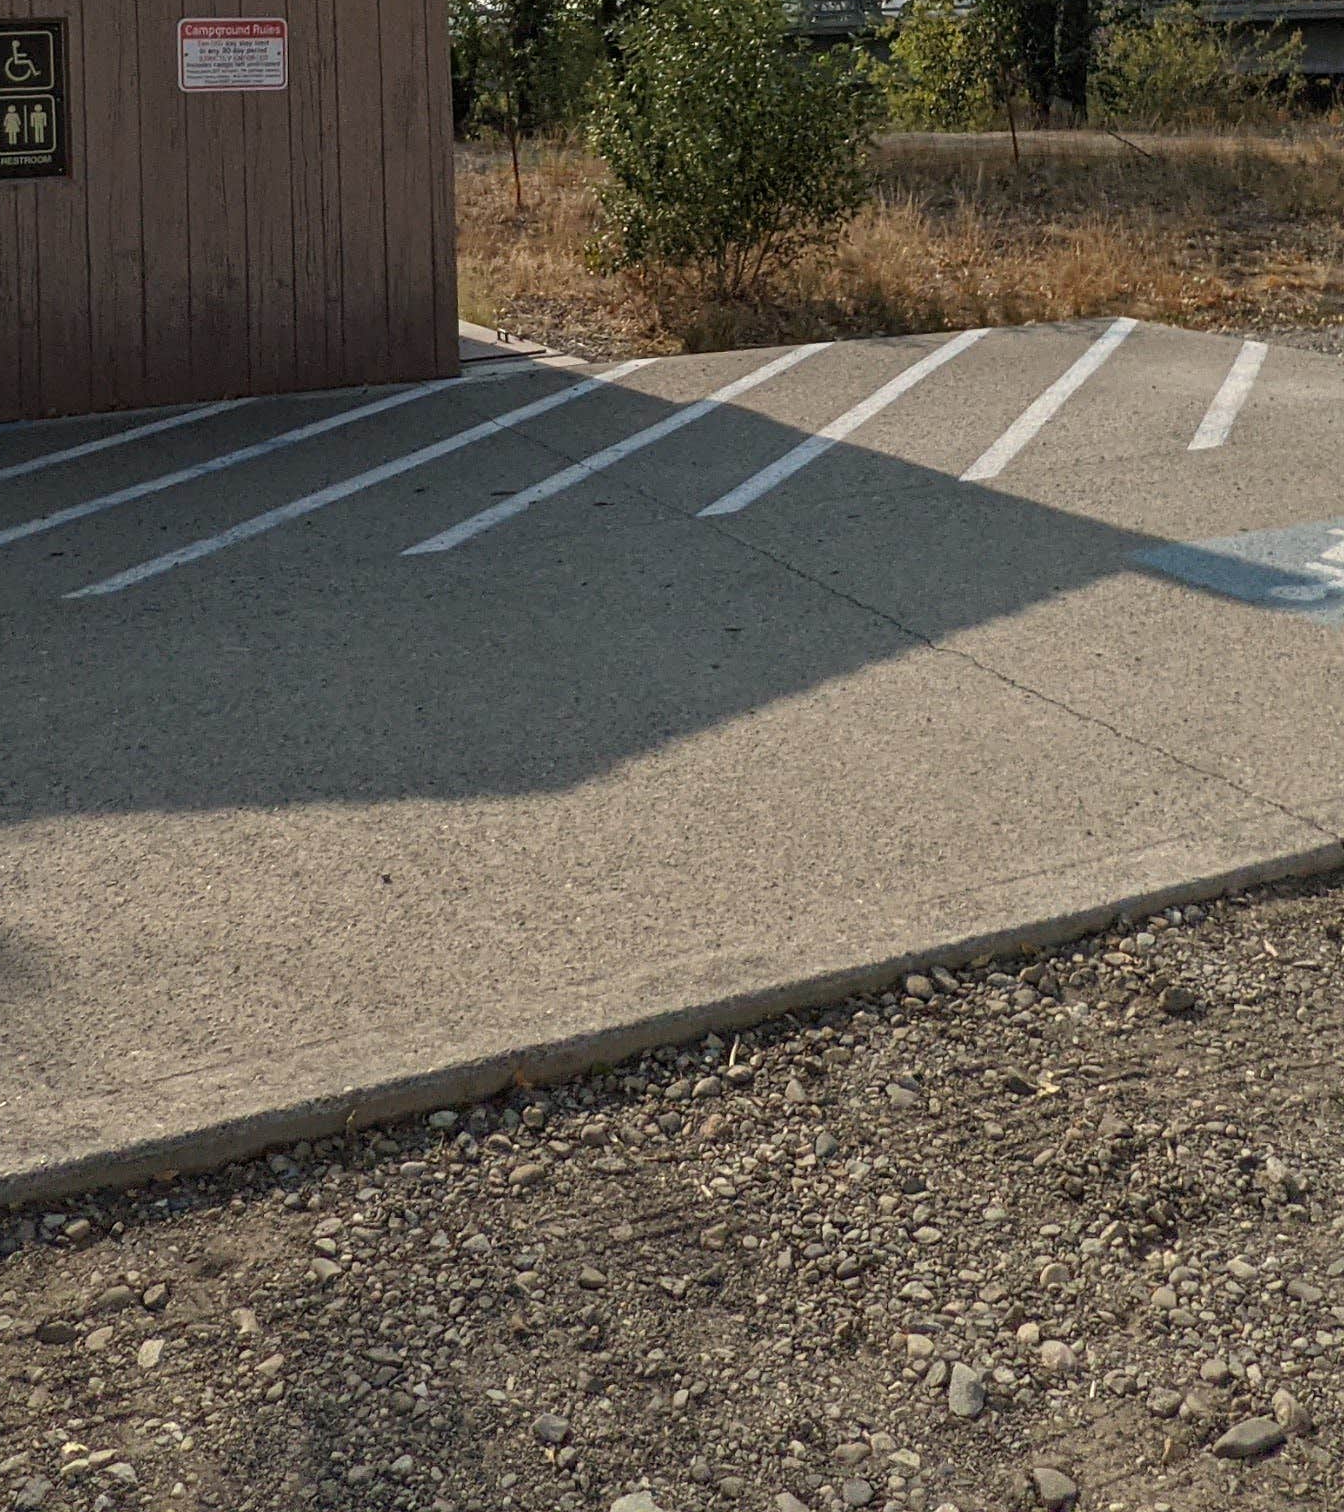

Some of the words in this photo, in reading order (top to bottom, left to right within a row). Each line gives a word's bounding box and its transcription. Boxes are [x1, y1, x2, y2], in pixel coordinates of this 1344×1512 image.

[185, 24, 250, 37] Campground
[253, 24, 281, 35] Rules
[0, 154, 53, 166] RESTROOM
